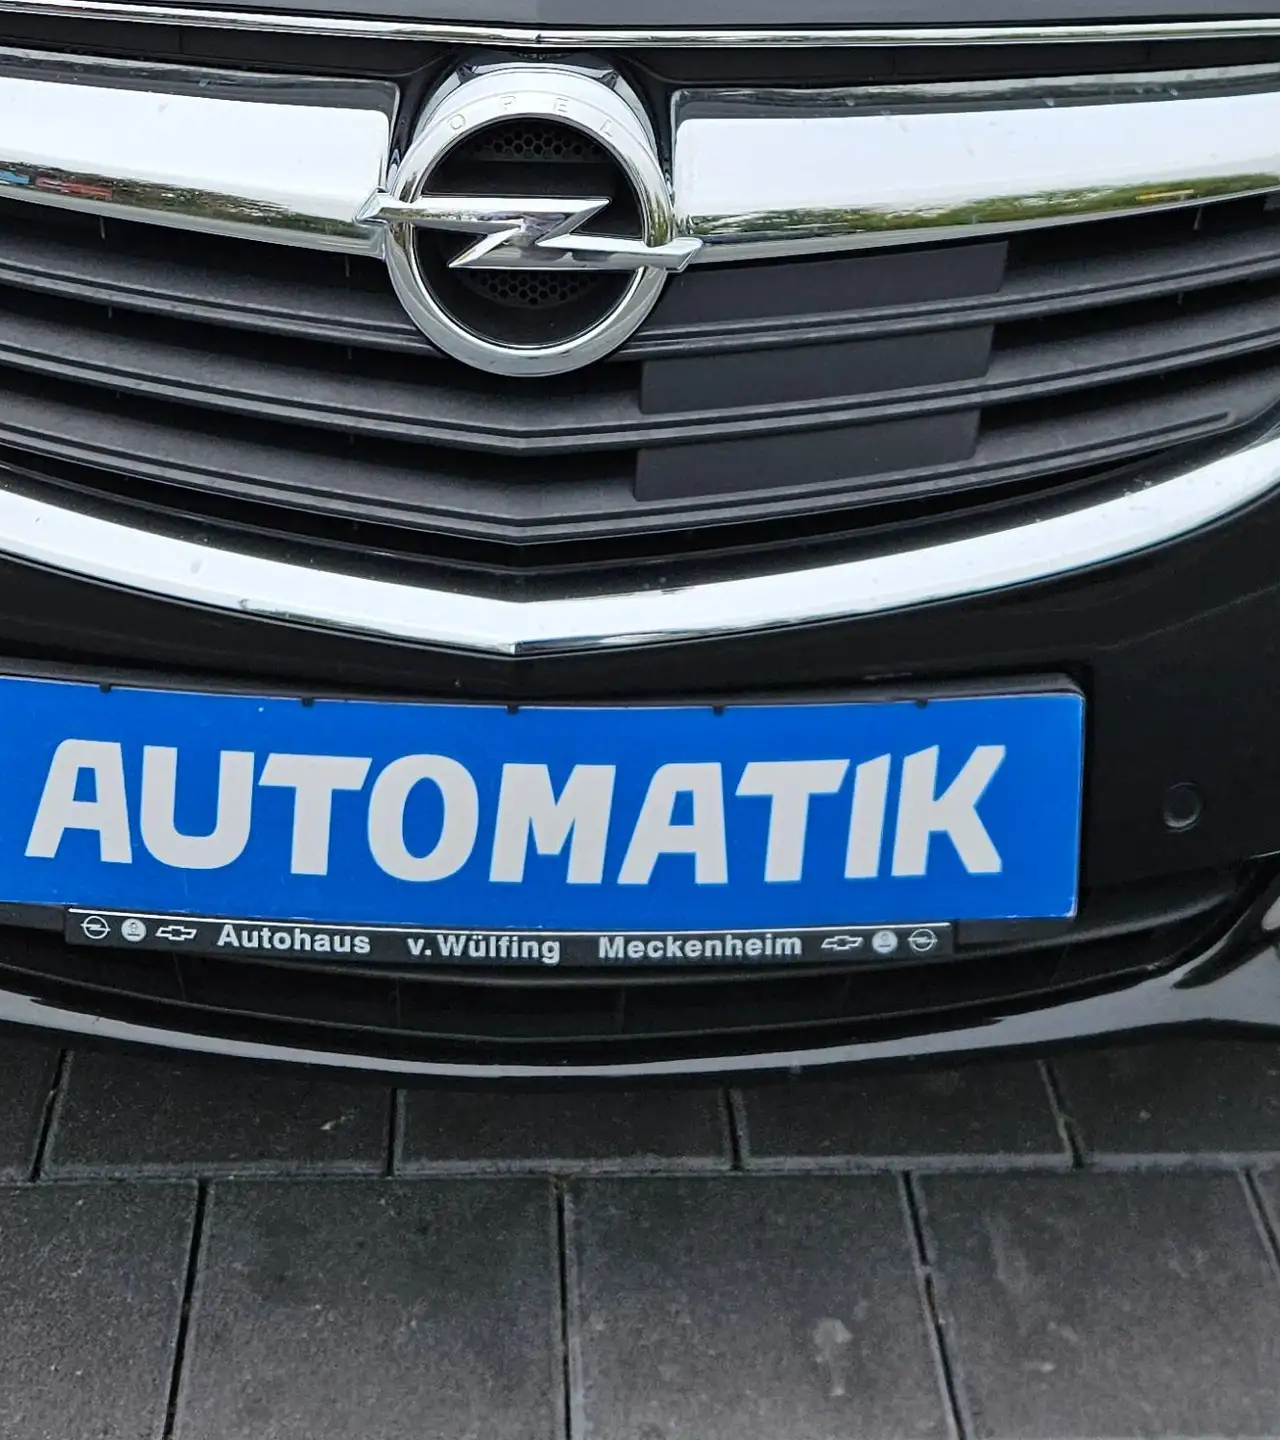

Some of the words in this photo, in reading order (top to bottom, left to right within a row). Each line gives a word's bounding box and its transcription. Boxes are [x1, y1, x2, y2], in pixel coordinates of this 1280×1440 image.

[447, 95, 615, 139] OPEL
[24, 738, 1005, 885] AUTOMATIK
[216, 924, 371, 954] Autohaus
[598, 934, 803, 960] Meckenheim
